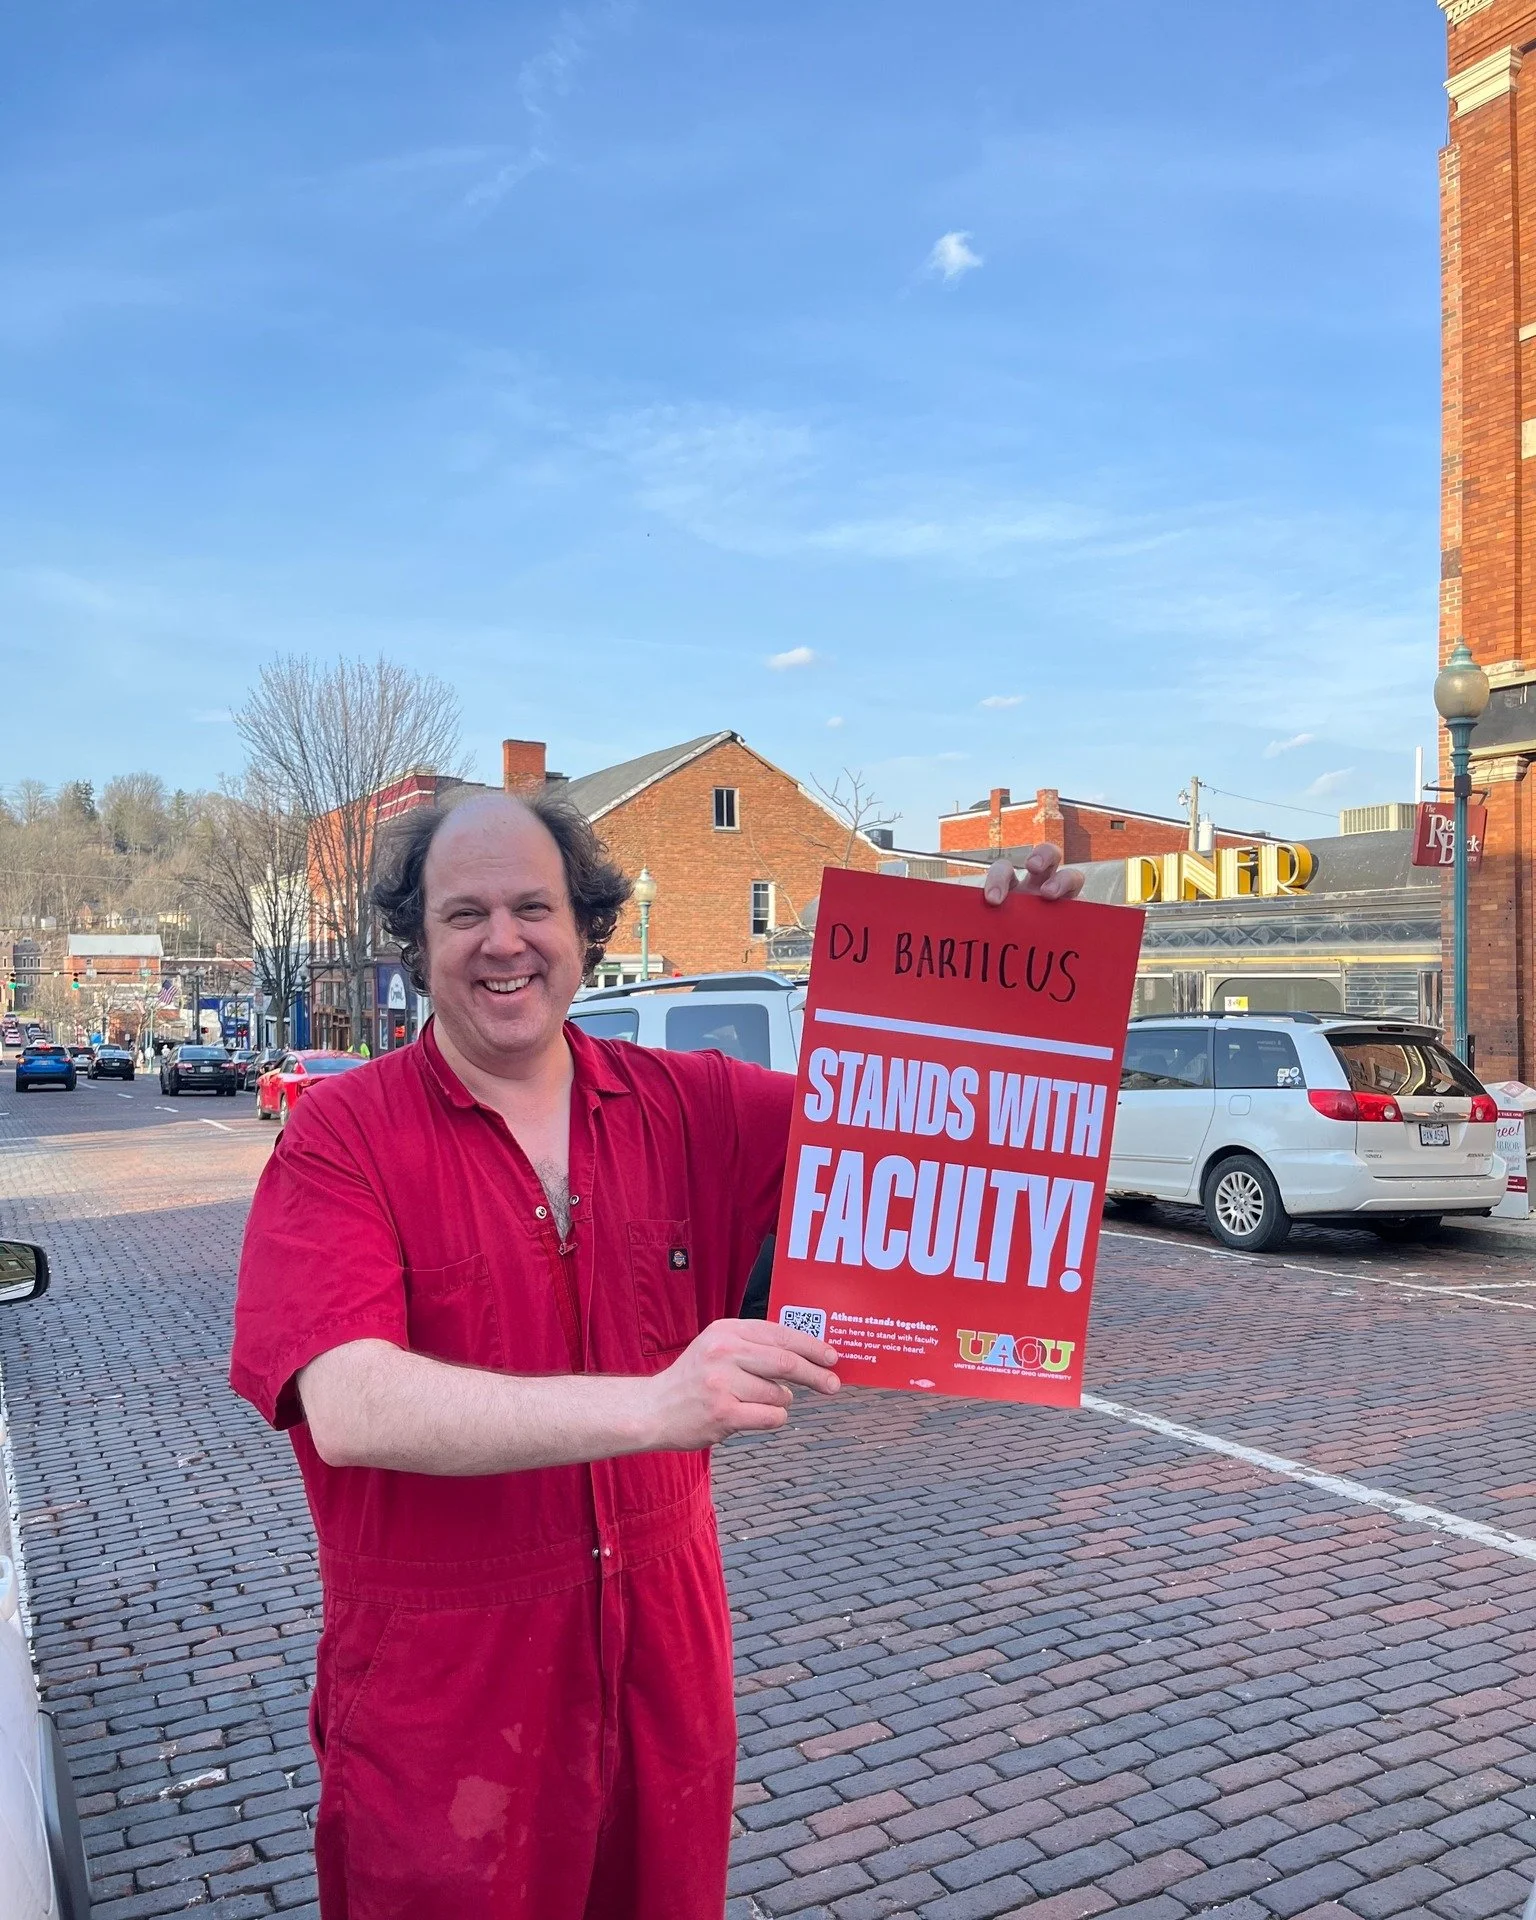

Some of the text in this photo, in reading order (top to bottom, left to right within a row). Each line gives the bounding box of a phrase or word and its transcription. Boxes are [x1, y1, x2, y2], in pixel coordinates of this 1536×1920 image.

[1425, 805, 1436, 813] The
[1426, 814, 1455, 848] Re
[1126, 843, 1313, 904] DINER
[829, 923, 1080, 1003] DJ BARTICUS
[804, 1047, 1107, 1158] STANDS WITH
[787, 1144, 1095, 1293] FACULTY!
[830, 1326, 847, 1335] Scan
[849, 1328, 865, 1337] here
[876, 1331, 896, 1340] stand
[898, 1334, 913, 1342] with
[914, 1335, 938, 1346] faculty
[831, 1312, 938, 1331] Athens stands together.
[843, 1339, 862, 1348] make
[864, 1341, 880, 1350] your
[882, 1343, 901, 1352] voice
[903, 1345, 926, 1354] heard.
[957, 1329, 1075, 1372] UAOU
[976, 1365, 1011, 1375] ACADEMICS
[1037, 1372, 1072, 1381] UNIVERSITY
